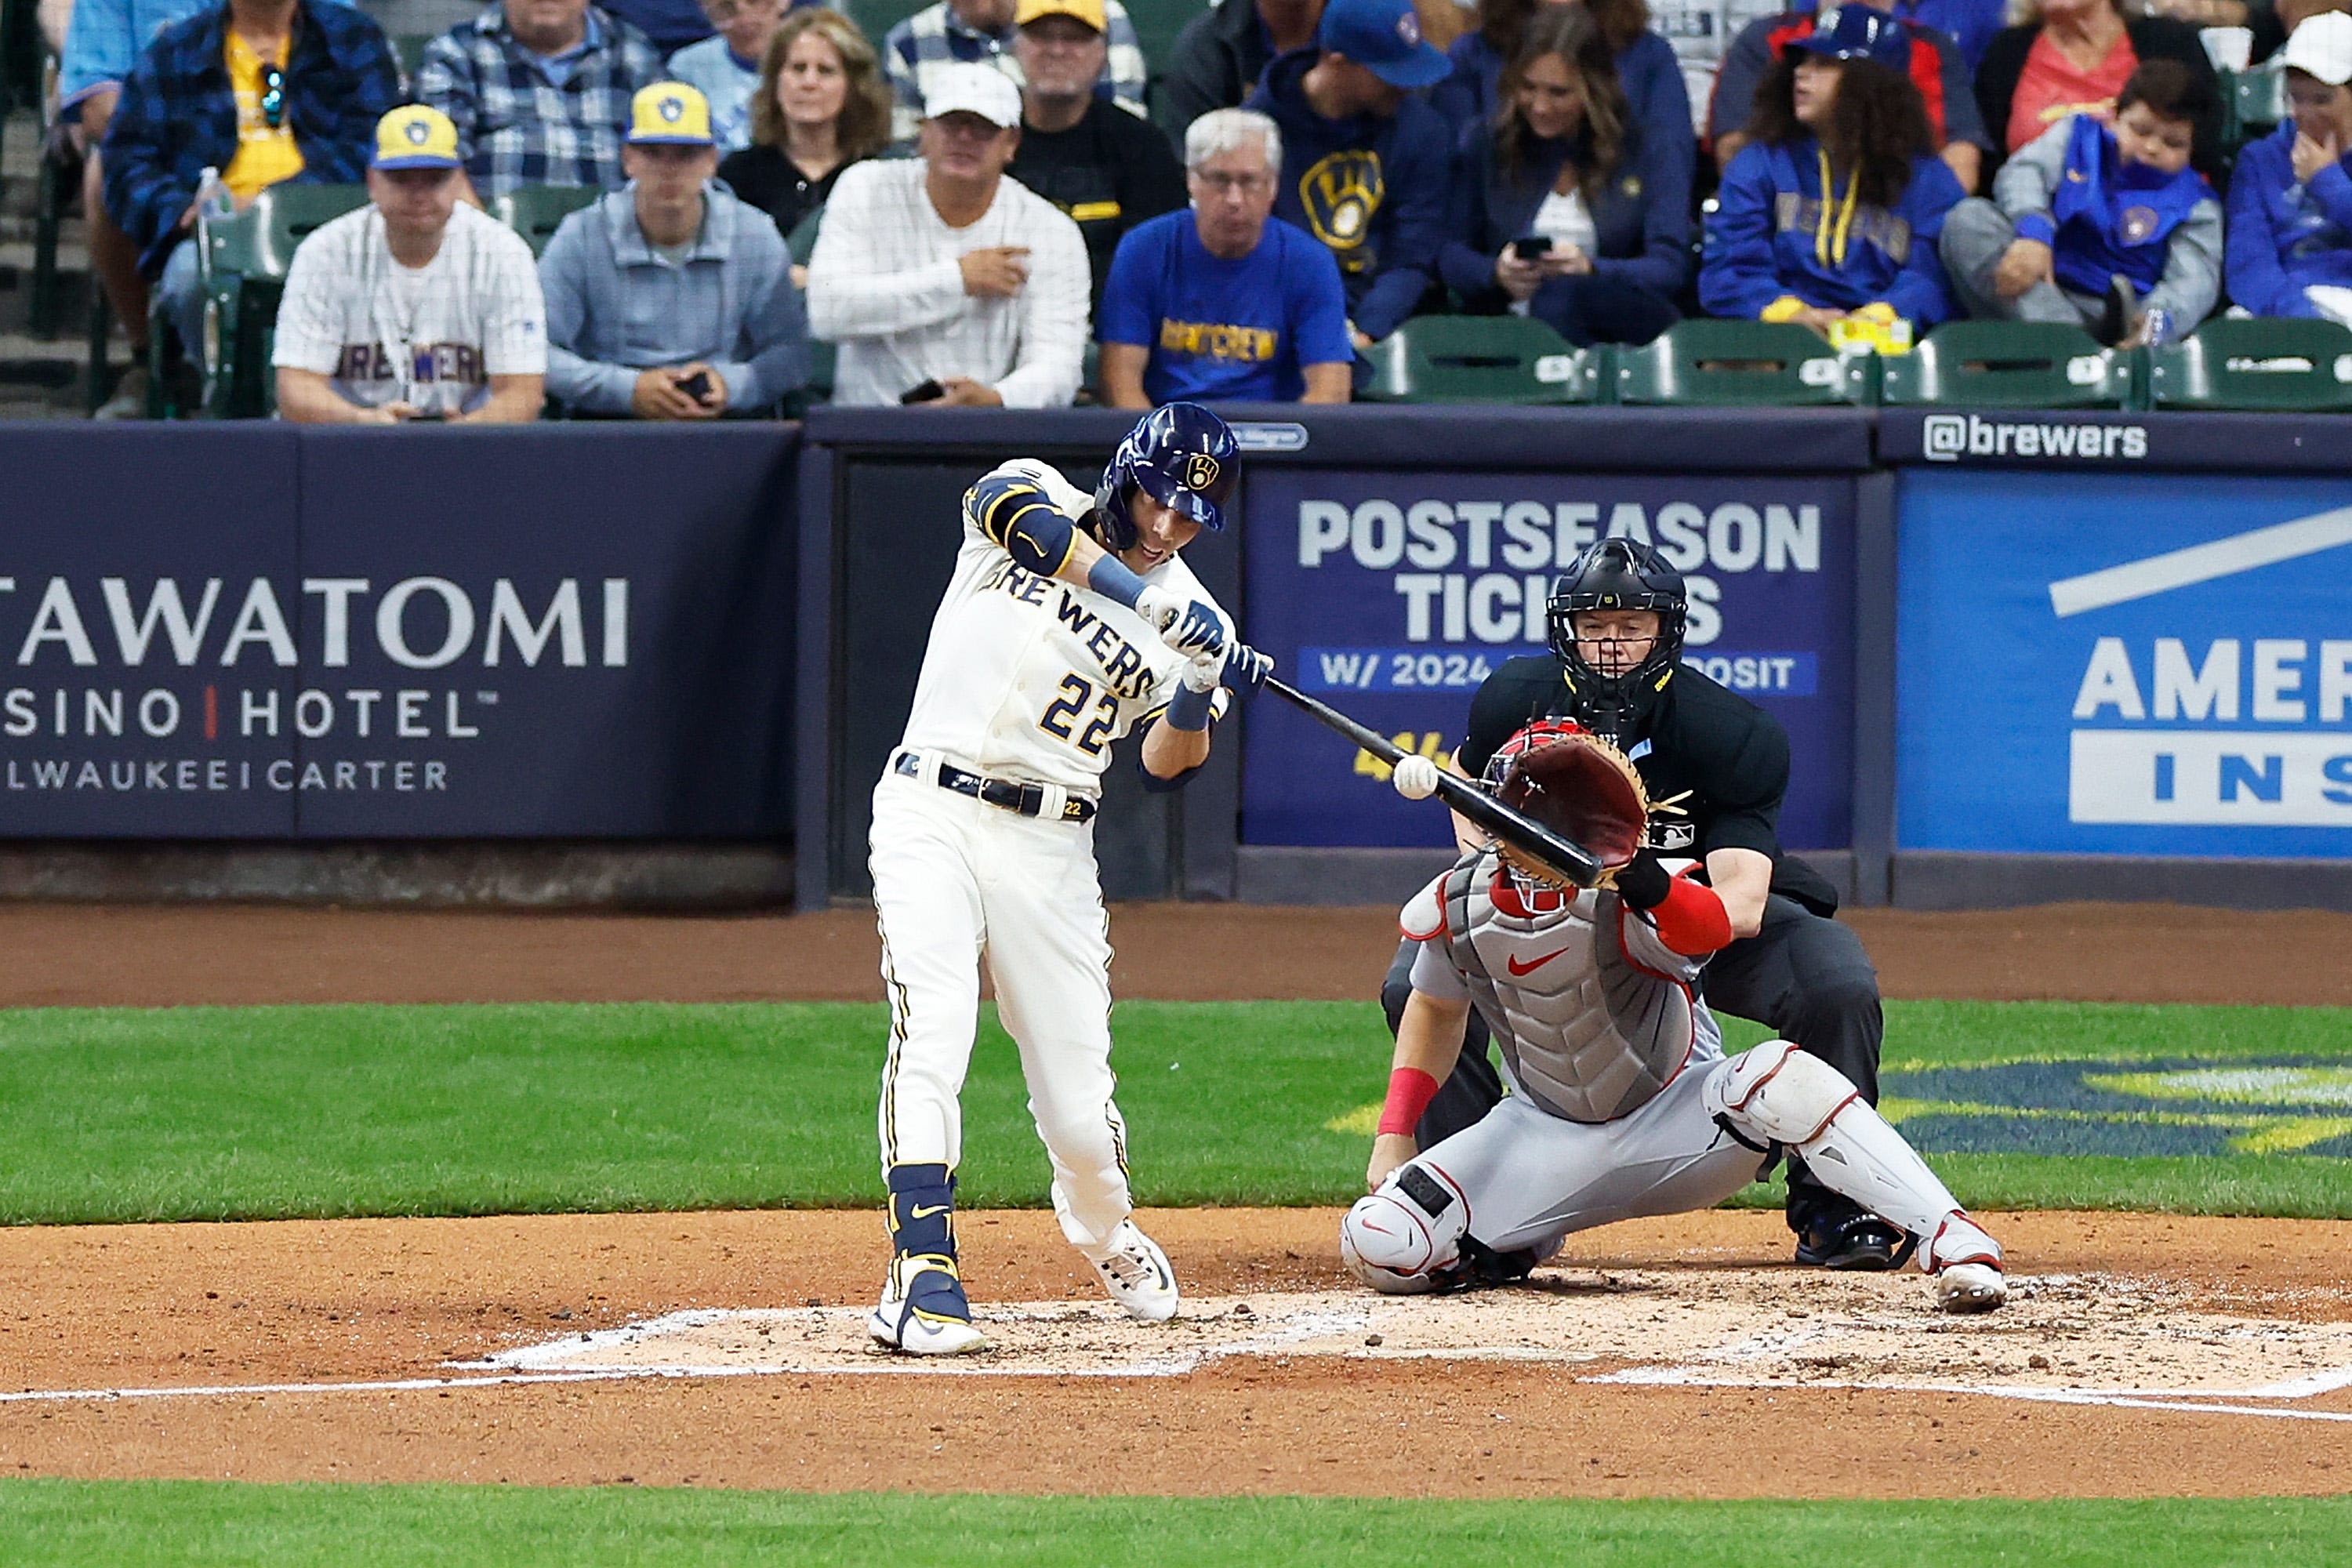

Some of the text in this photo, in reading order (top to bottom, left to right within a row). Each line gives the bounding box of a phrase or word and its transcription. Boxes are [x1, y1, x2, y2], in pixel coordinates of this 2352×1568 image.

[1923, 414, 2148, 461] @brewers
[1298, 499, 1820, 572] POSTSEASON
[0, 575, 627, 670] AWATOMI
[978, 556, 1156, 699] REWERS
[1395, 573, 1723, 646] TICS
[1319, 653, 1380, 688] W/
[4, 688, 180, 737] SINO
[1036, 670, 1121, 757] 22
[6, 760, 448, 790] LWAUKEE CARTER
[1064, 800, 1080, 815] 22
